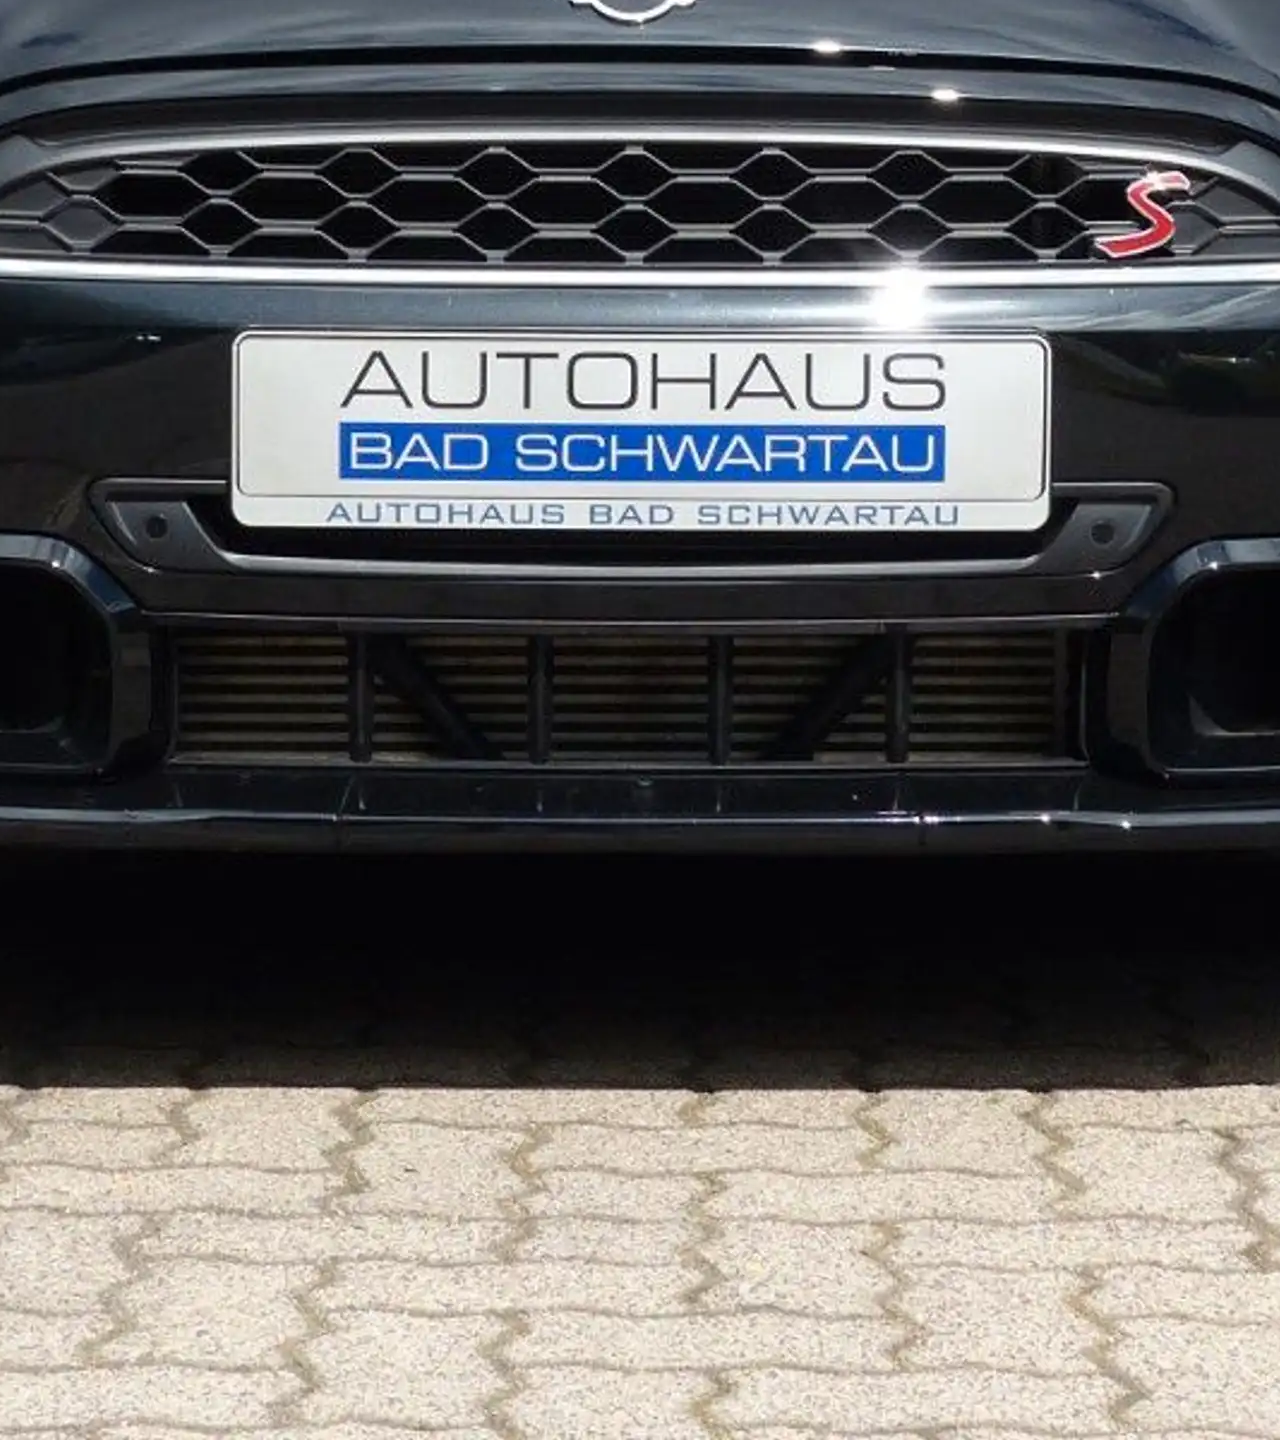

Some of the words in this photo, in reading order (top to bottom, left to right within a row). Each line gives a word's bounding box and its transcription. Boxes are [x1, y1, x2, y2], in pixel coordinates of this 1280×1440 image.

[1094, 171, 1191, 258] S
[339, 349, 946, 412] AUTOHAUS
[349, 432, 490, 474] BAD
[515, 431, 935, 474] SCHWARTAU
[325, 501, 565, 527] AUTOHAUS
[588, 503, 675, 527] BAD
[696, 503, 960, 528] SCHWARTAU
